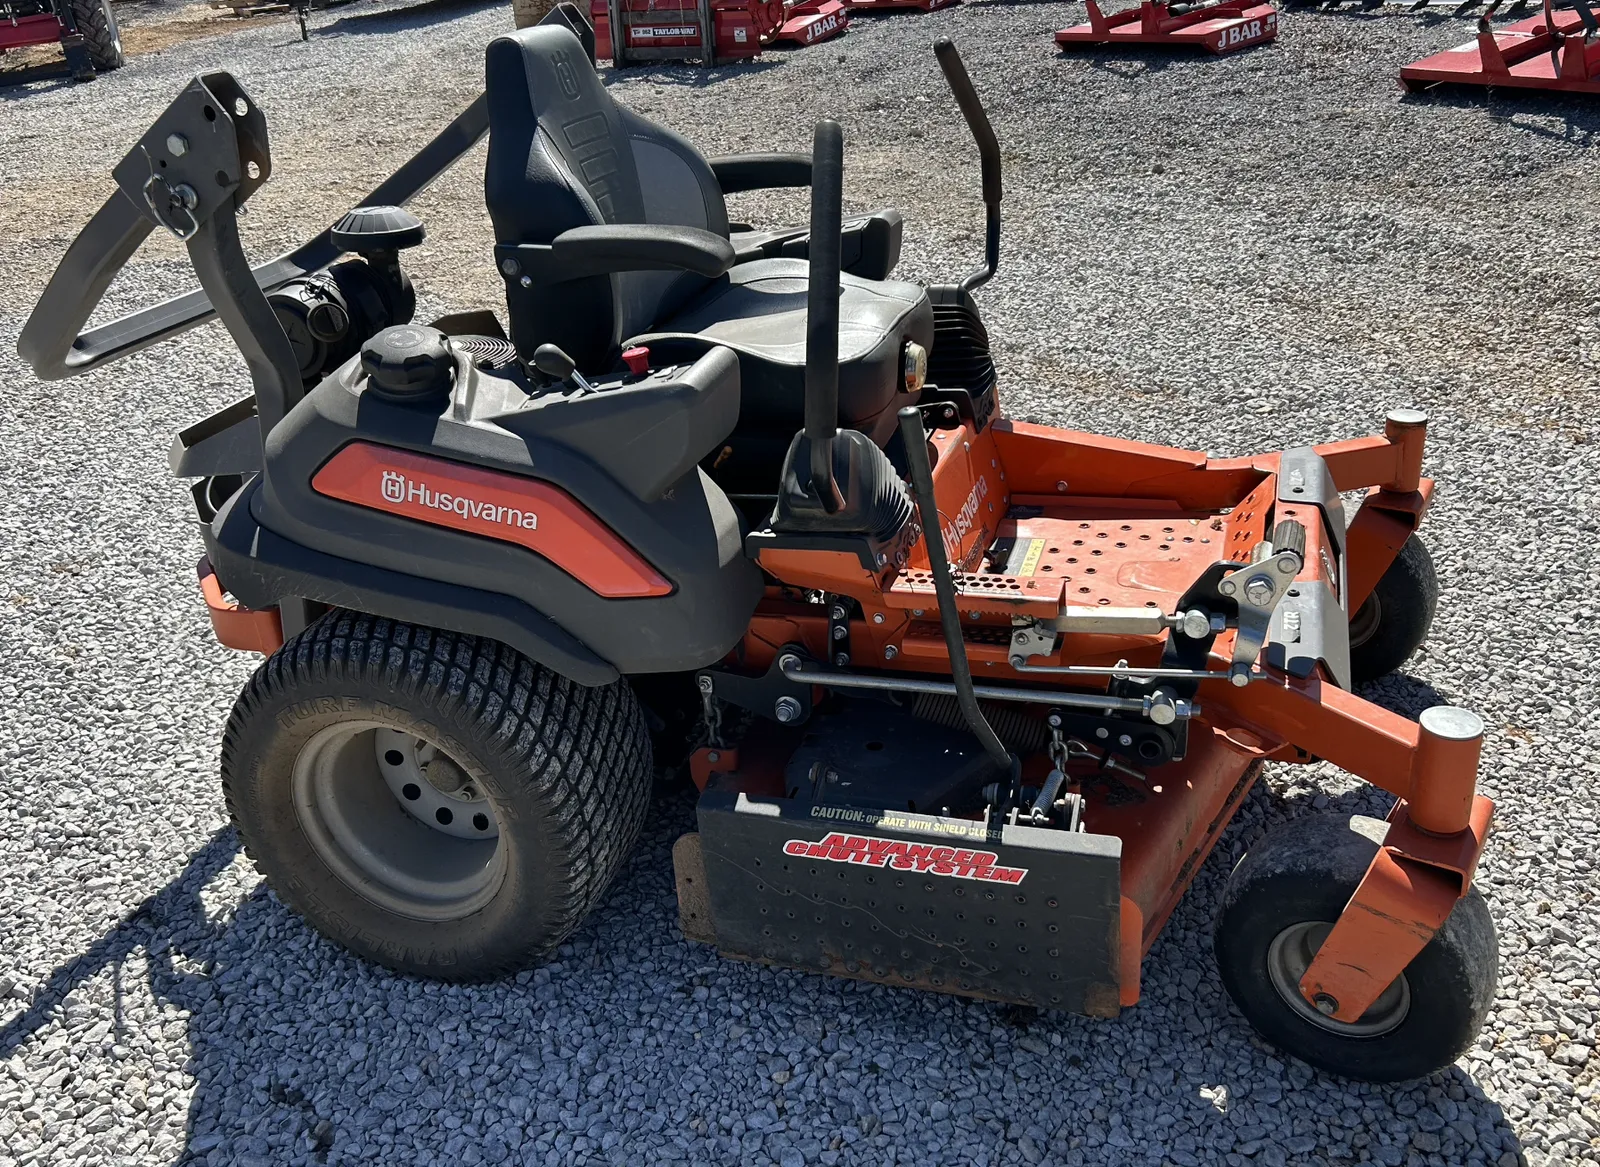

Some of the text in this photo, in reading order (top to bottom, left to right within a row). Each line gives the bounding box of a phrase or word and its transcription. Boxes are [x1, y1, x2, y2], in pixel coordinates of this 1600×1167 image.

[806, 26, 814, 42] J
[813, 15, 838, 36] BAR
[1217, 30, 1227, 51] J
[1229, 20, 1262, 45] BAR
[407, 480, 539, 530] Husqvarna
[944, 474, 988, 553] Husqvarna
[275, 695, 520, 820] TURF MASTER
[810, 805, 1005, 840] CAUTION: OPERATE WITH SHIELD CLOSED
[785, 841, 1026, 884] CHUTE SYSTEM
[820, 833, 997, 866] ADVANCED
